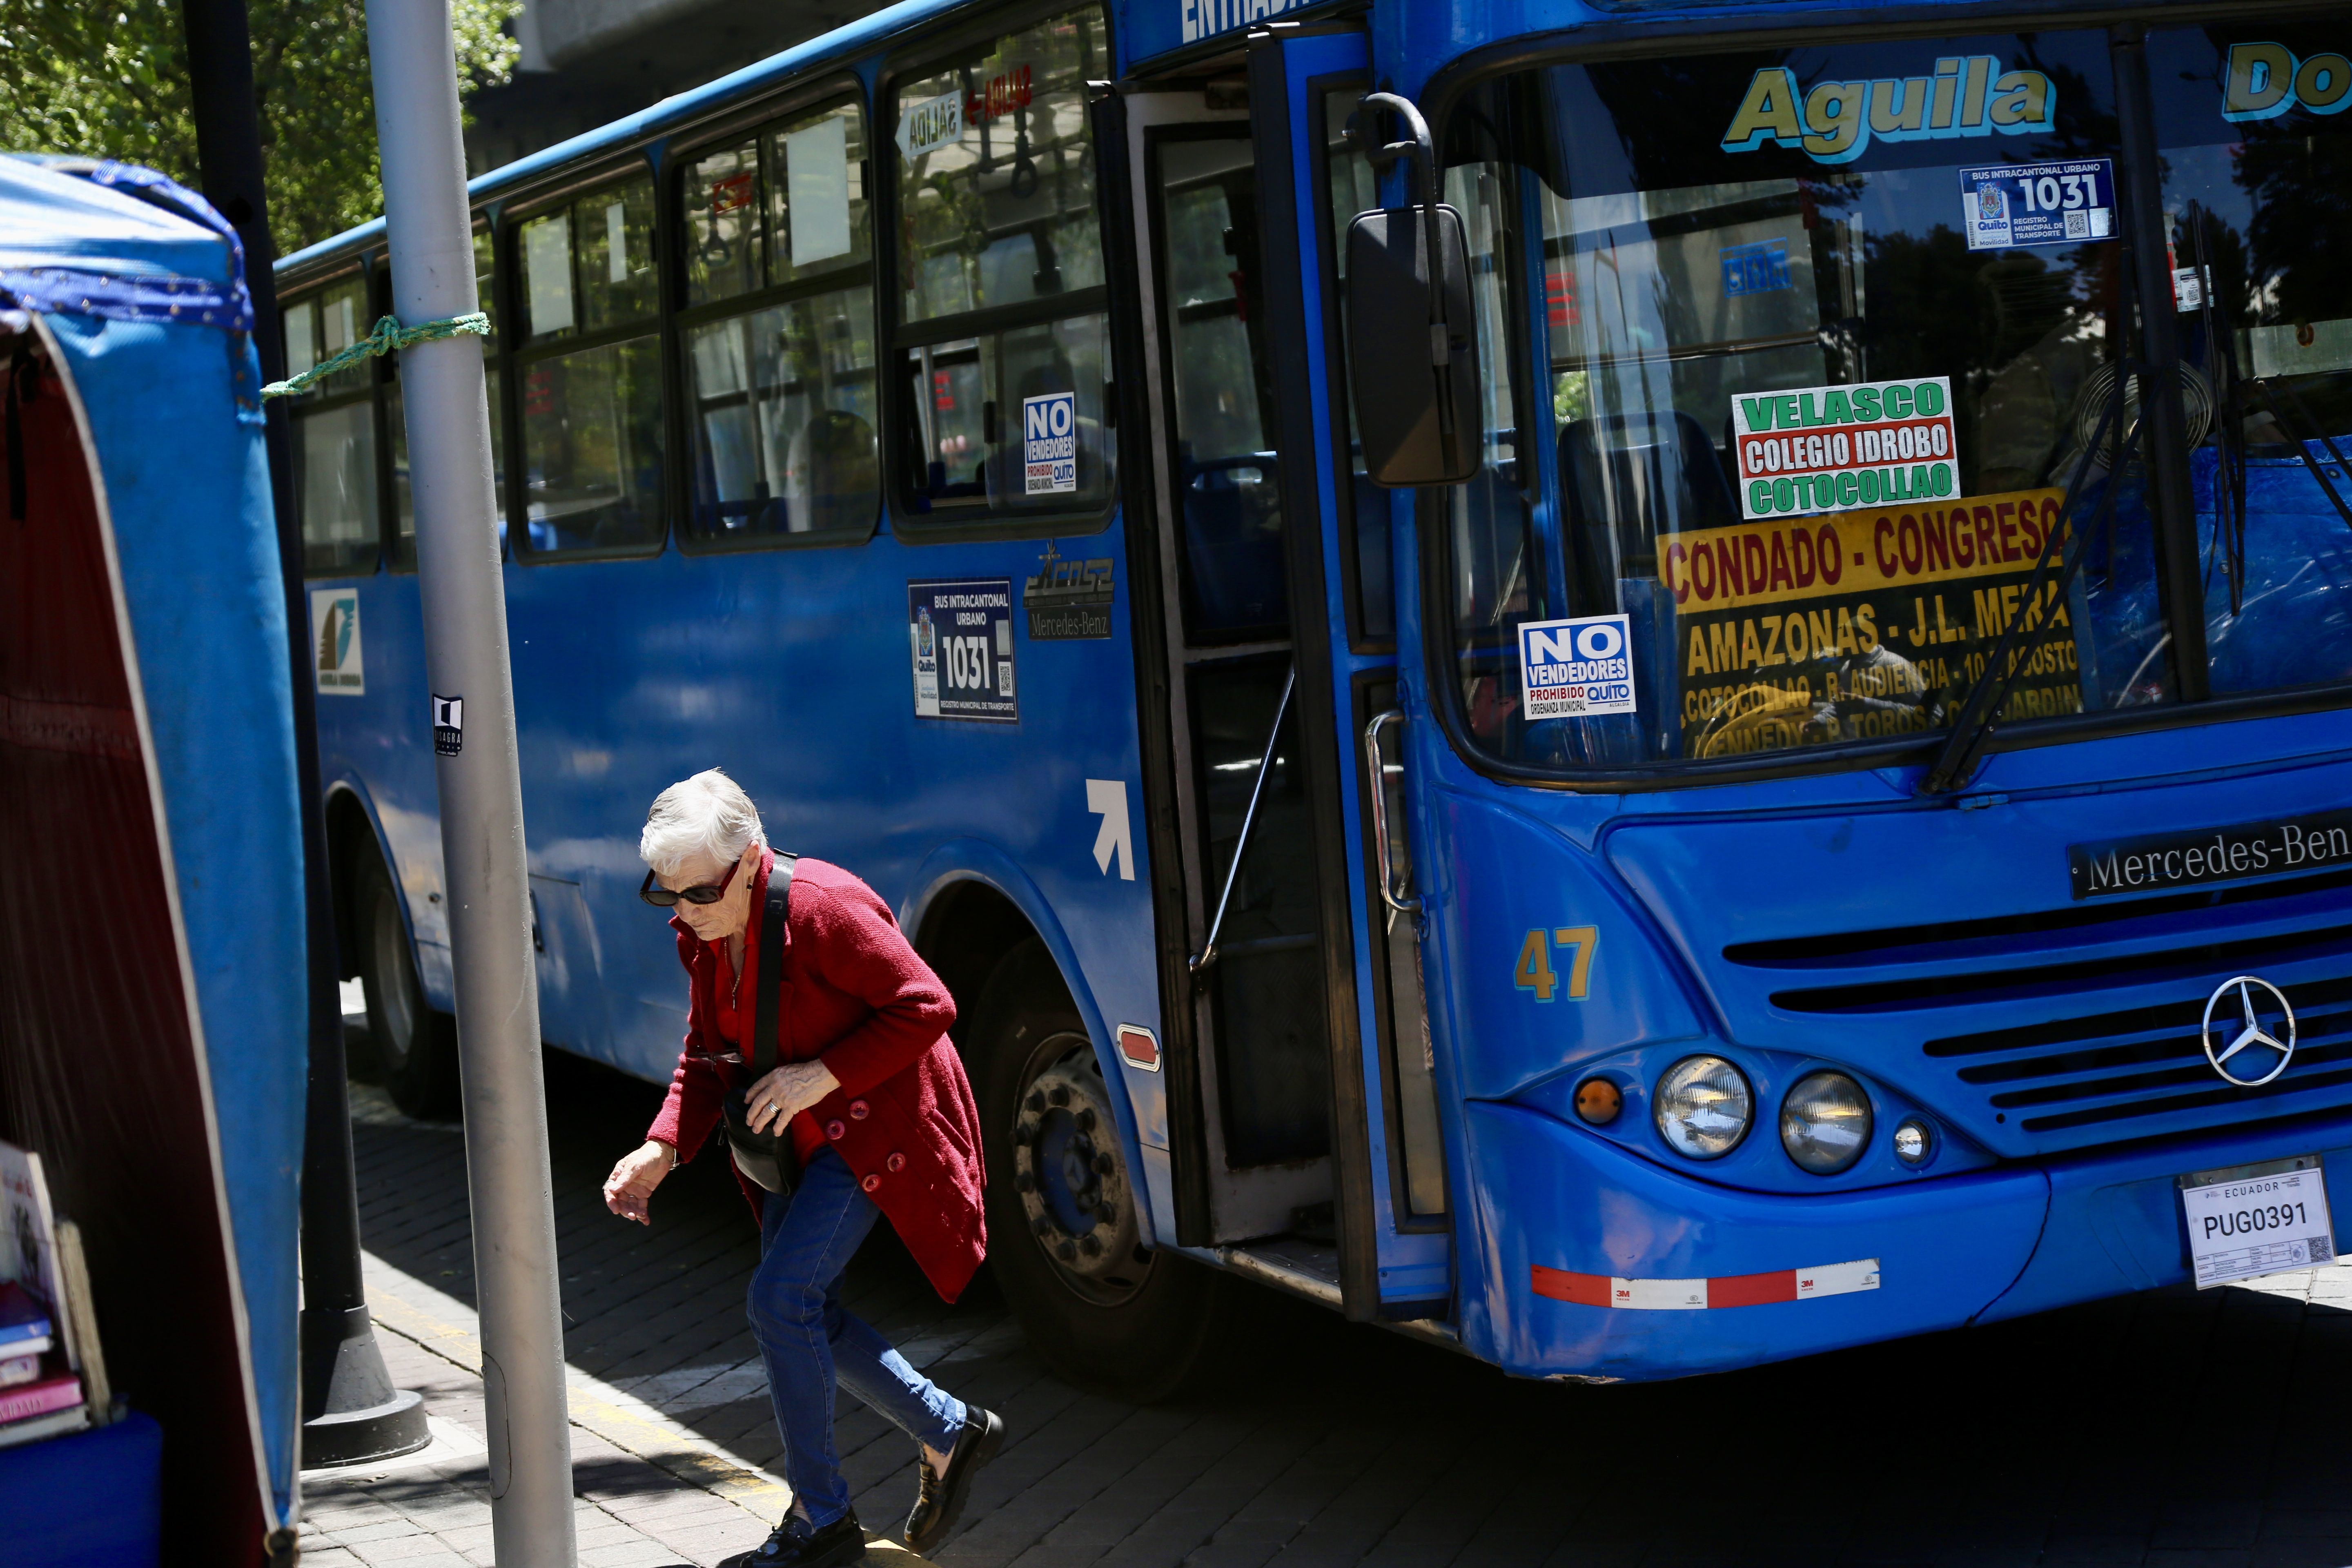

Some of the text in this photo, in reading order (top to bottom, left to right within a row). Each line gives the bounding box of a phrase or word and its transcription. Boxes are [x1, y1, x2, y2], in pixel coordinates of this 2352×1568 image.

[2222, 42, 2352, 123] Do
[1720, 54, 2056, 164] Aguila
[1973, 164, 2100, 180] BUS INTRACANTONAL URBANO
[2019, 174, 2098, 212] 1031
[1978, 220, 2008, 231] Quito
[2015, 224, 2052, 232] MUNICIPAL
[2015, 231, 2060, 239] TRANSPORTE
[1028, 400, 1071, 439] NO
[1741, 383, 1944, 431] VELASCO
[1027, 436, 1072, 461] VENDEDORES
[1746, 423, 1948, 474] COLEGIO IDROBO
[1027, 464, 1052, 477] PROHIBIDO
[1749, 463, 1952, 514] COTOCOLLAO
[1666, 497, 2064, 604] CONDADO CONGRESO
[934, 594, 1008, 608] BUS INTRACANTONAL
[956, 612, 986, 625] URBANO
[1032, 612, 1107, 635] Mercedes-Benz
[1529, 624, 1622, 664] NO
[1688, 603, 1879, 676] AMAZONAS
[918, 659, 935, 672] Quito
[942, 636, 990, 689] 1031
[1528, 658, 1626, 686] VENDEDORES
[1851, 657, 1951, 700] AUDIENCIA
[1964, 652, 1985, 684] 10
[988, 702, 1014, 710] TRANSPORTE
[1530, 686, 1584, 701] PROHIBIDO
[1531, 700, 1586, 715] ORDENANZA MUNICIPAL
[1850, 705, 1927, 738] TOROS
[1514, 924, 1600, 1003] 47
[2226, 1182, 2278, 1198] ECUADOR
[2205, 1202, 2306, 1239] PUG0391
